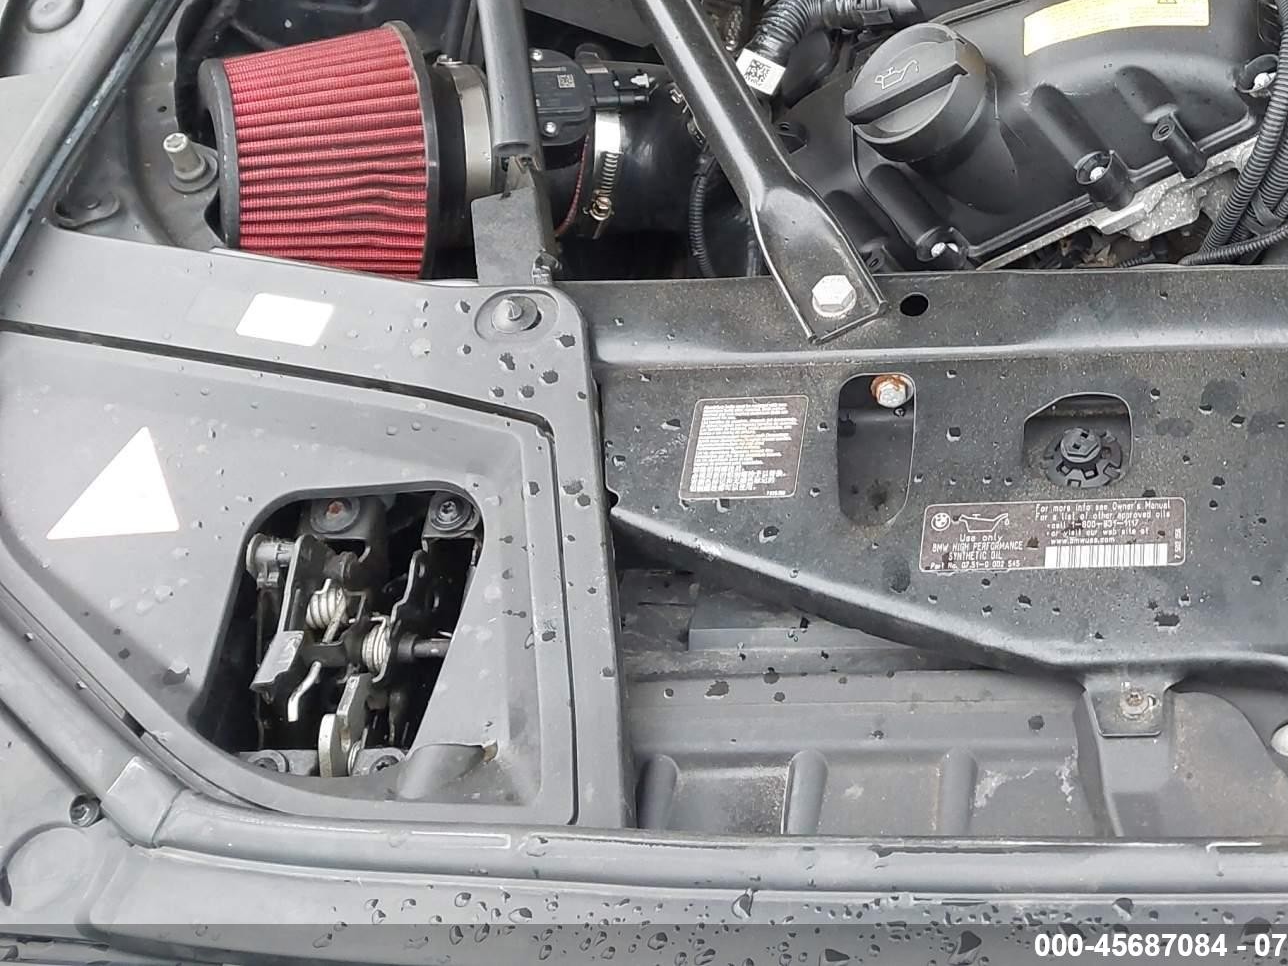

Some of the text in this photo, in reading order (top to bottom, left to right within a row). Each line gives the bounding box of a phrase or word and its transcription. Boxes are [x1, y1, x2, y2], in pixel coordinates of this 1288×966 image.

[1036, 504, 1048, 513] For
[1075, 502, 1091, 511] info
[1112, 501, 1141, 510] Owner's
[1145, 500, 1170, 509] Manual
[1035, 512, 1047, 521] For
[1061, 511, 1075, 520] list
[1080, 511, 1087, 520] of
[1093, 510, 1112, 519] other
[1117, 510, 1151, 520] approved
[1155, 509, 1170, 518] oils
[960, 532, 1003, 542] Use only
[1062, 529, 1082, 537] visit
[1122, 527, 1136, 535] site
[932, 541, 1023, 553] BMW HIGH PERFORMANCE
[948, 551, 1003, 561] SYNTHETIC OIL
